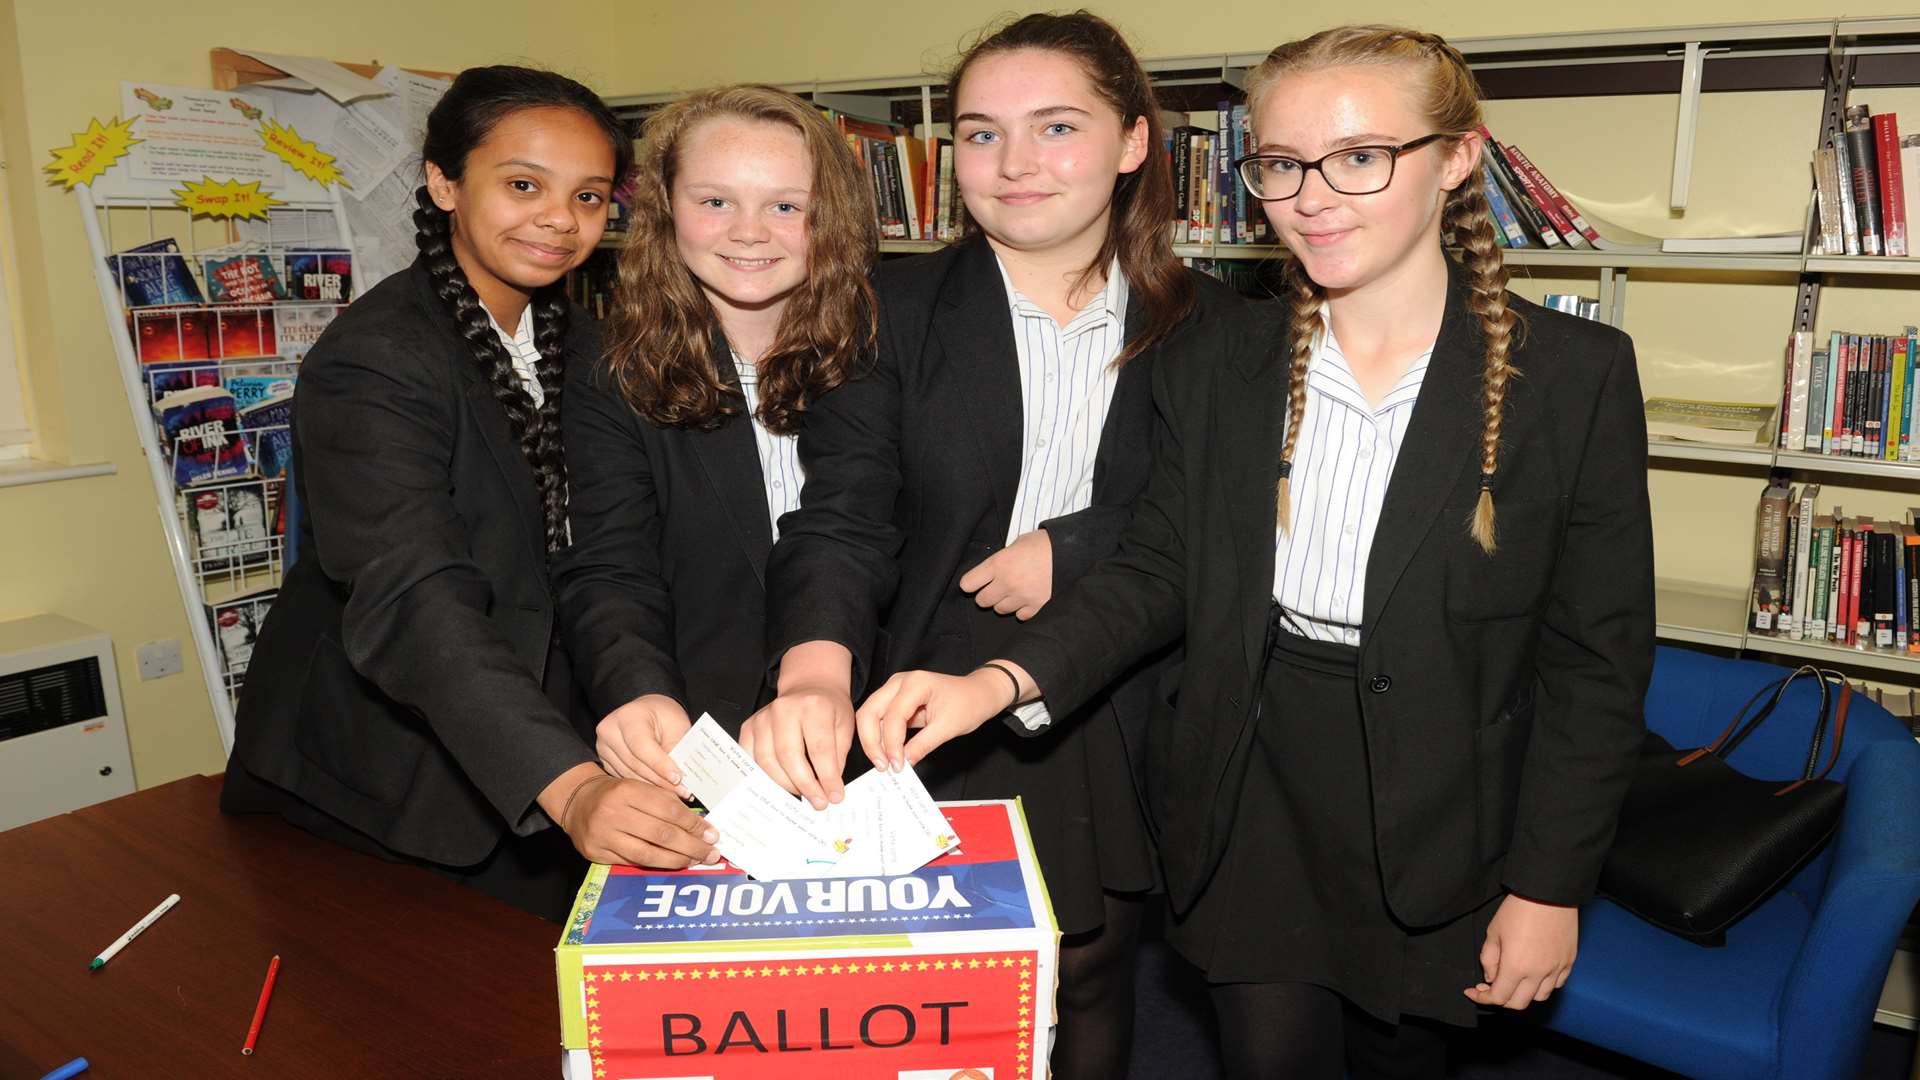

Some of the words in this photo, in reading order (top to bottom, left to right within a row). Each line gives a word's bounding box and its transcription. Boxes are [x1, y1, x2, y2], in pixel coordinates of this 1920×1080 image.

[69, 148, 96, 175] Read
[90, 133, 108, 151] It!
[268, 132, 307, 160] Review
[310, 154, 327, 170] It!
[1512, 165, 1535, 189] SPORT
[1529, 169, 1558, 199] ANATOMY
[195, 192, 229, 205] Swap
[234, 192, 250, 203] It!
[304, 274, 342, 288] RIVER
[230, 386, 266, 400] PERRY
[179, 420, 225, 442] RIVER
[201, 432, 229, 450] INK
[1763, 514, 1772, 528] THE
[1764, 504, 1772, 513] OF
[1772, 511, 1781, 522] THE
[1800, 500, 1809, 526] POETRY
[1761, 531, 1770, 557] WORLD
[1770, 526, 1780, 552] WINTER
[637, 879, 799, 918] VOICE
[806, 875, 972, 912] YOUR
[661, 1001, 969, 1057] BALLOT
